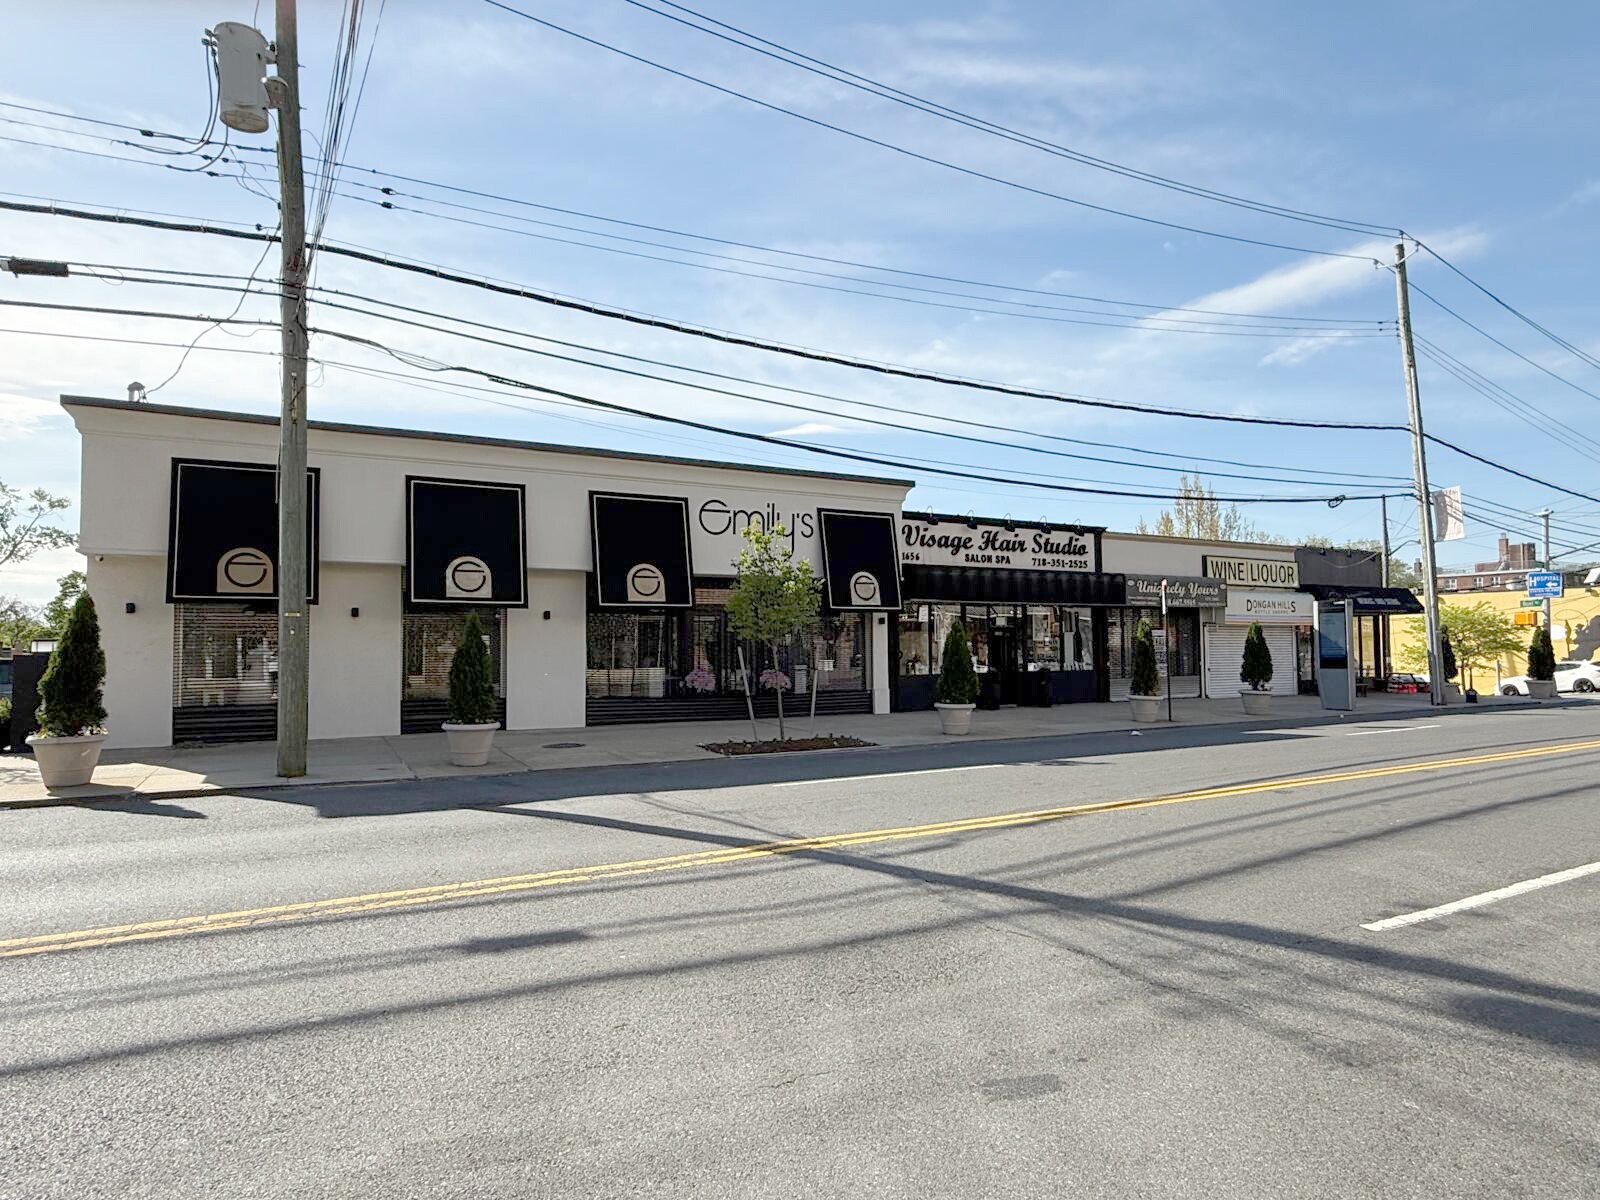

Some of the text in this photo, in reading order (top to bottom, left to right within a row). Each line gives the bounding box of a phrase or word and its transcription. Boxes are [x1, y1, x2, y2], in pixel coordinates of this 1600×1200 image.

[699, 499, 814, 559] Emily's
[901, 524, 1089, 556] Visage Hair Studio
[901, 551, 920, 561] 1656
[964, 553, 1011, 565] SALON SPA
[1031, 557, 1089, 569] 718-351-2525
[1210, 559, 1295, 584] WINE LIQUOR
[1529, 575, 1560, 587] HOSPITAL
[1187, 582, 1219, 597] Yours
[1246, 599, 1296, 613] DONGAN HILLS
